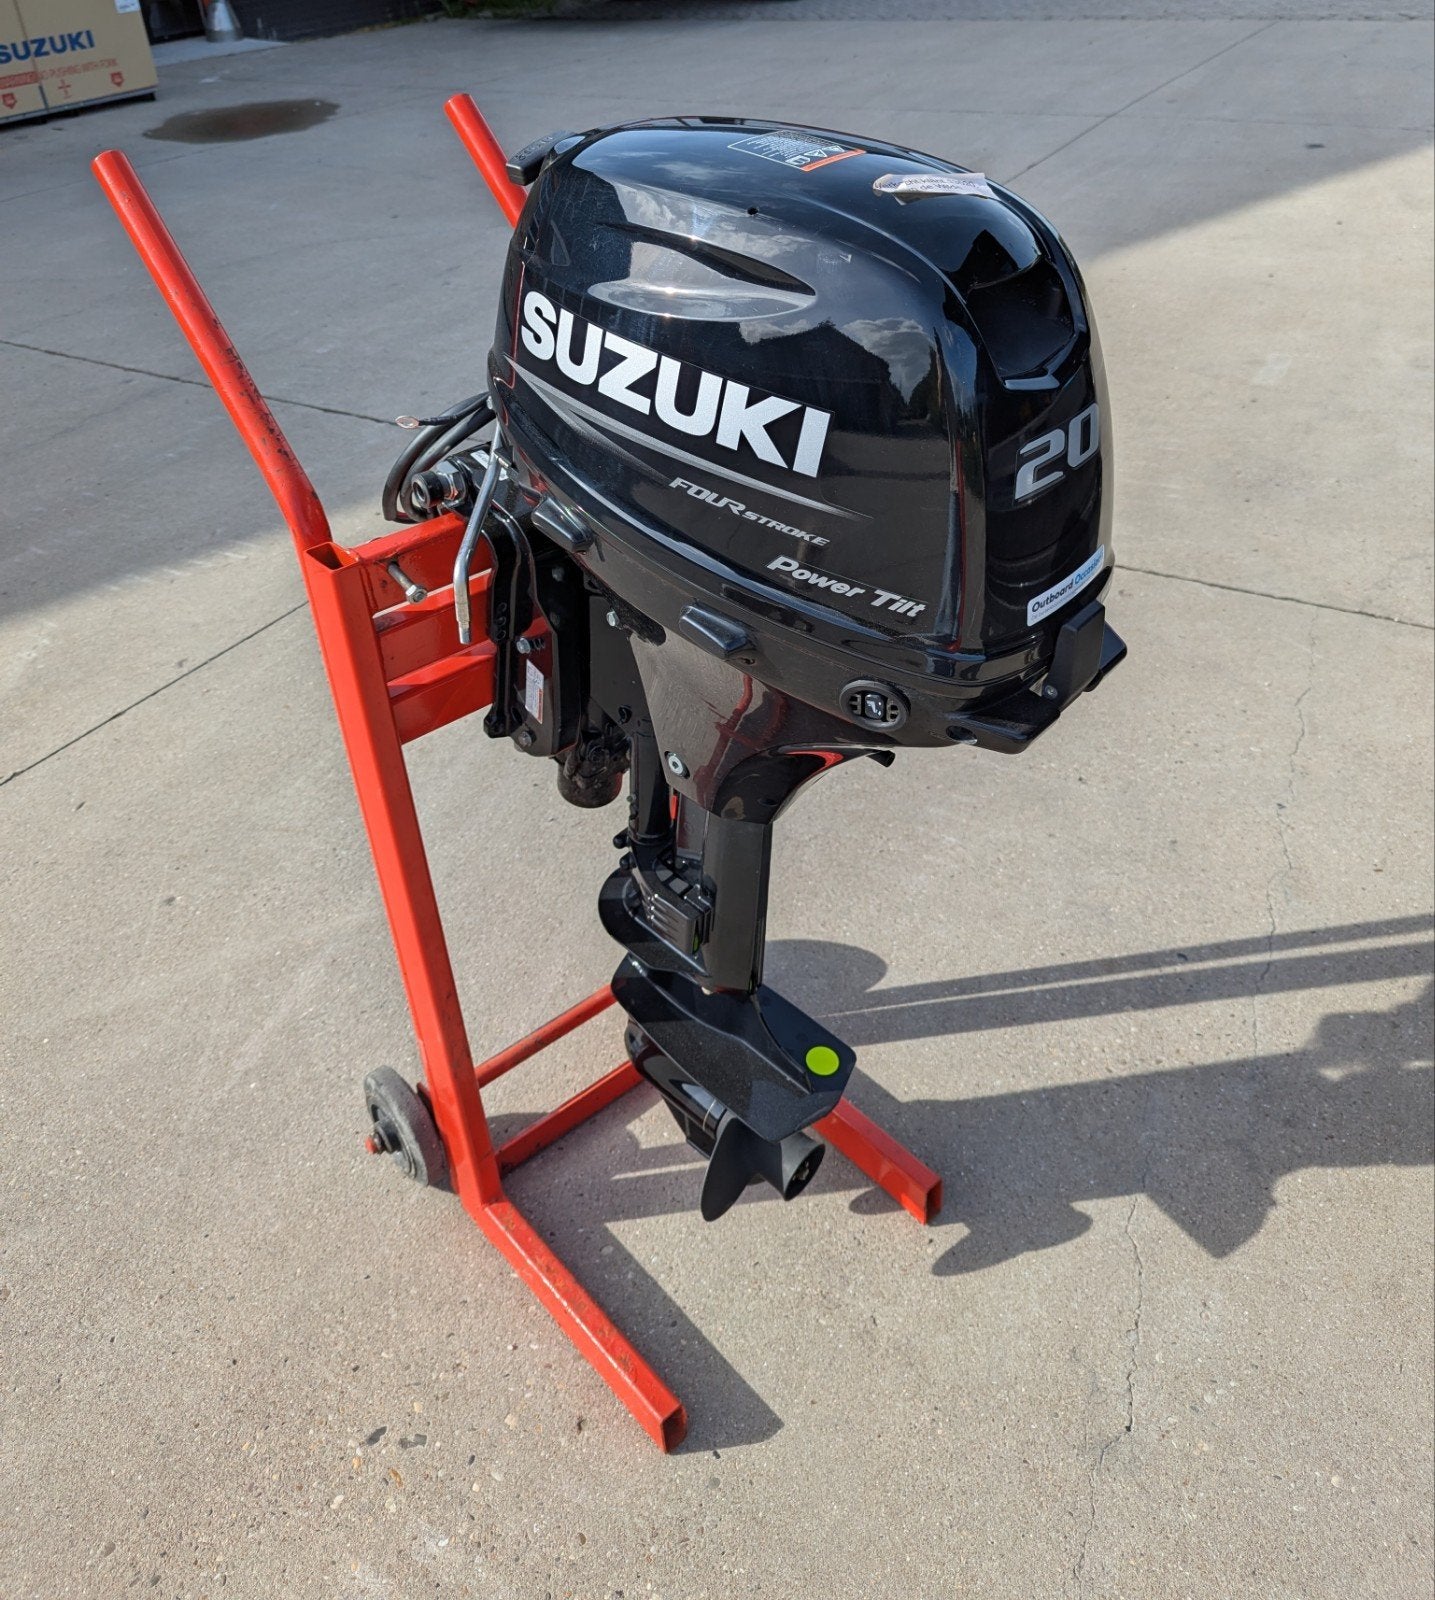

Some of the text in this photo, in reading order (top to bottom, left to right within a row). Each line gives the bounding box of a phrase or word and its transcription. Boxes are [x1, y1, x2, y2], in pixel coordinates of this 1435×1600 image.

[0, 30, 95, 64] SUZUKI
[522, 290, 830, 478] SUZUKI
[1015, 403, 1099, 500] 20
[767, 556, 927, 617] Power Tilt
[1032, 579, 1074, 612] Outboard
